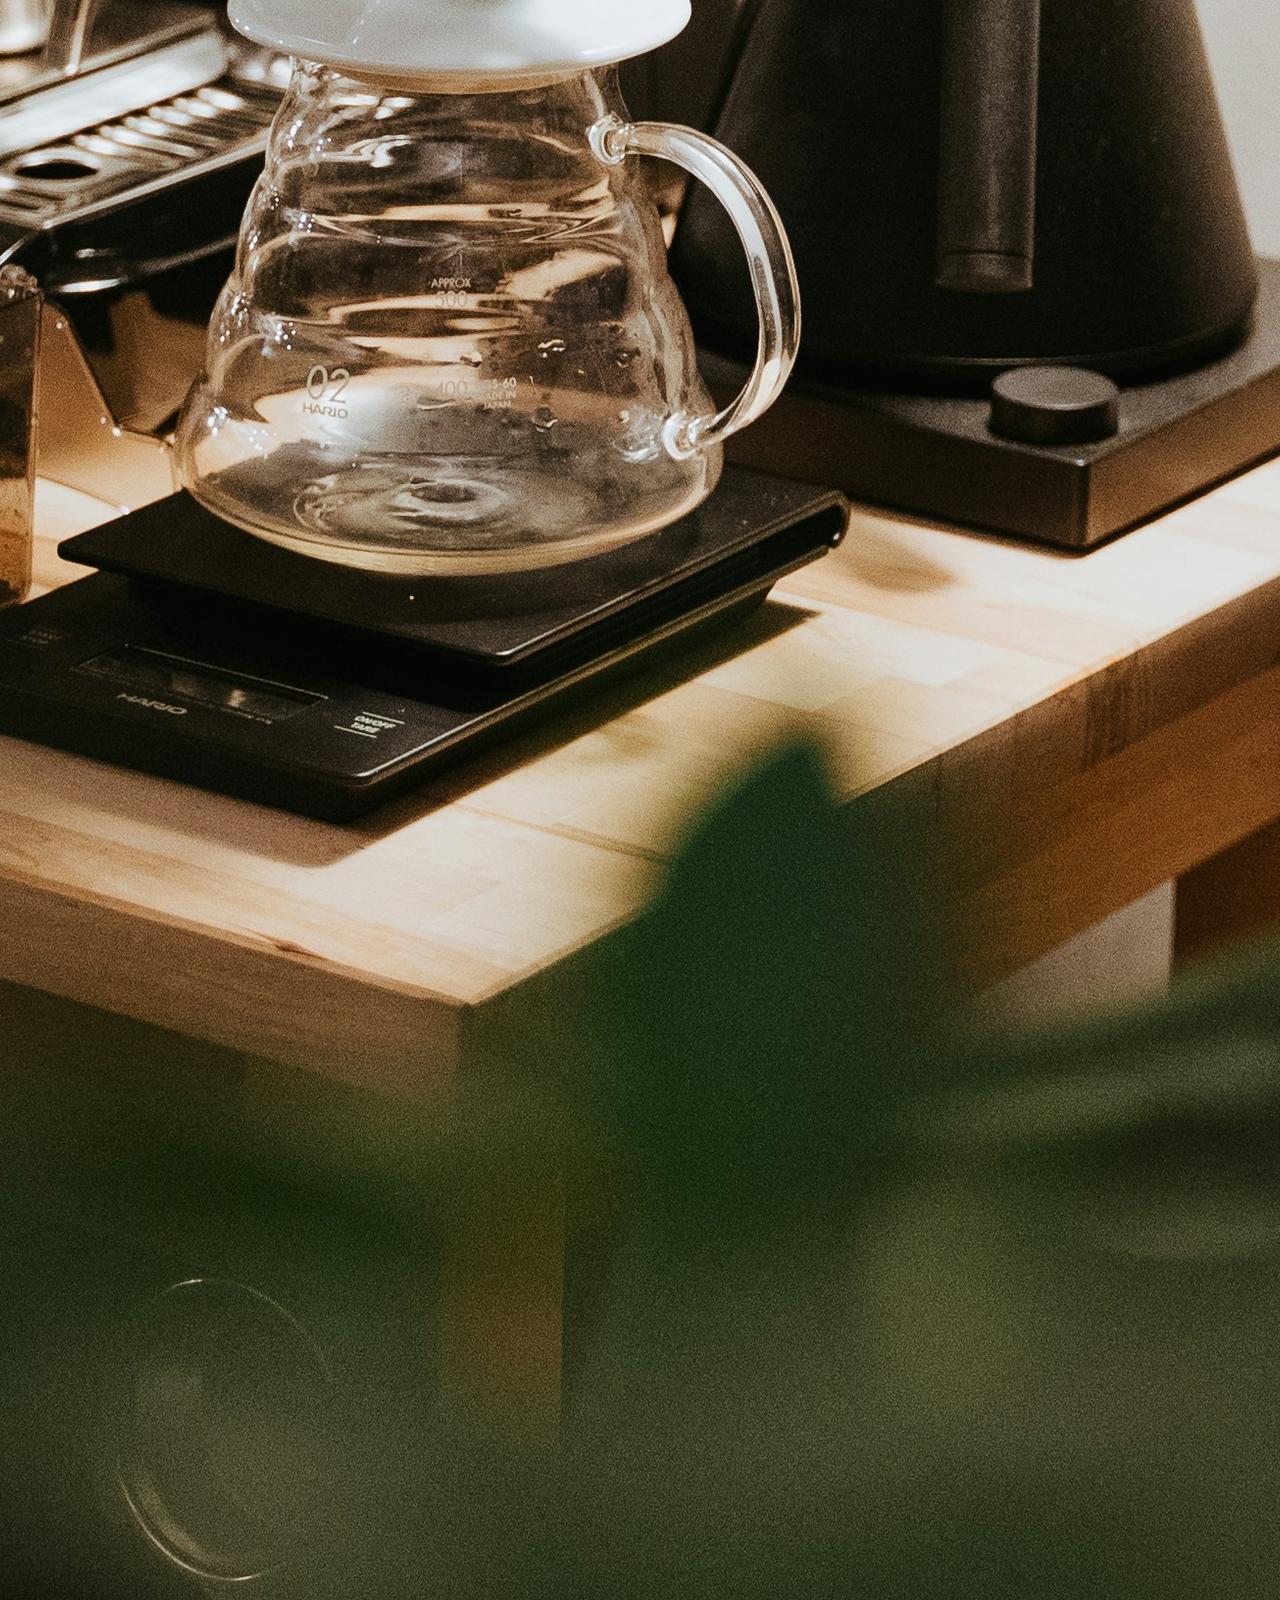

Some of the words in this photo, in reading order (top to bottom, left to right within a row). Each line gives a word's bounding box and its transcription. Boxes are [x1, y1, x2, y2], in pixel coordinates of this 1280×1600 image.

[430, 276, 472, 289] APPROX
[435, 290, 468, 309] 500
[306, 364, 351, 404] 02
[302, 402, 349, 419] HARIO
[116, 692, 188, 715] HARIO
